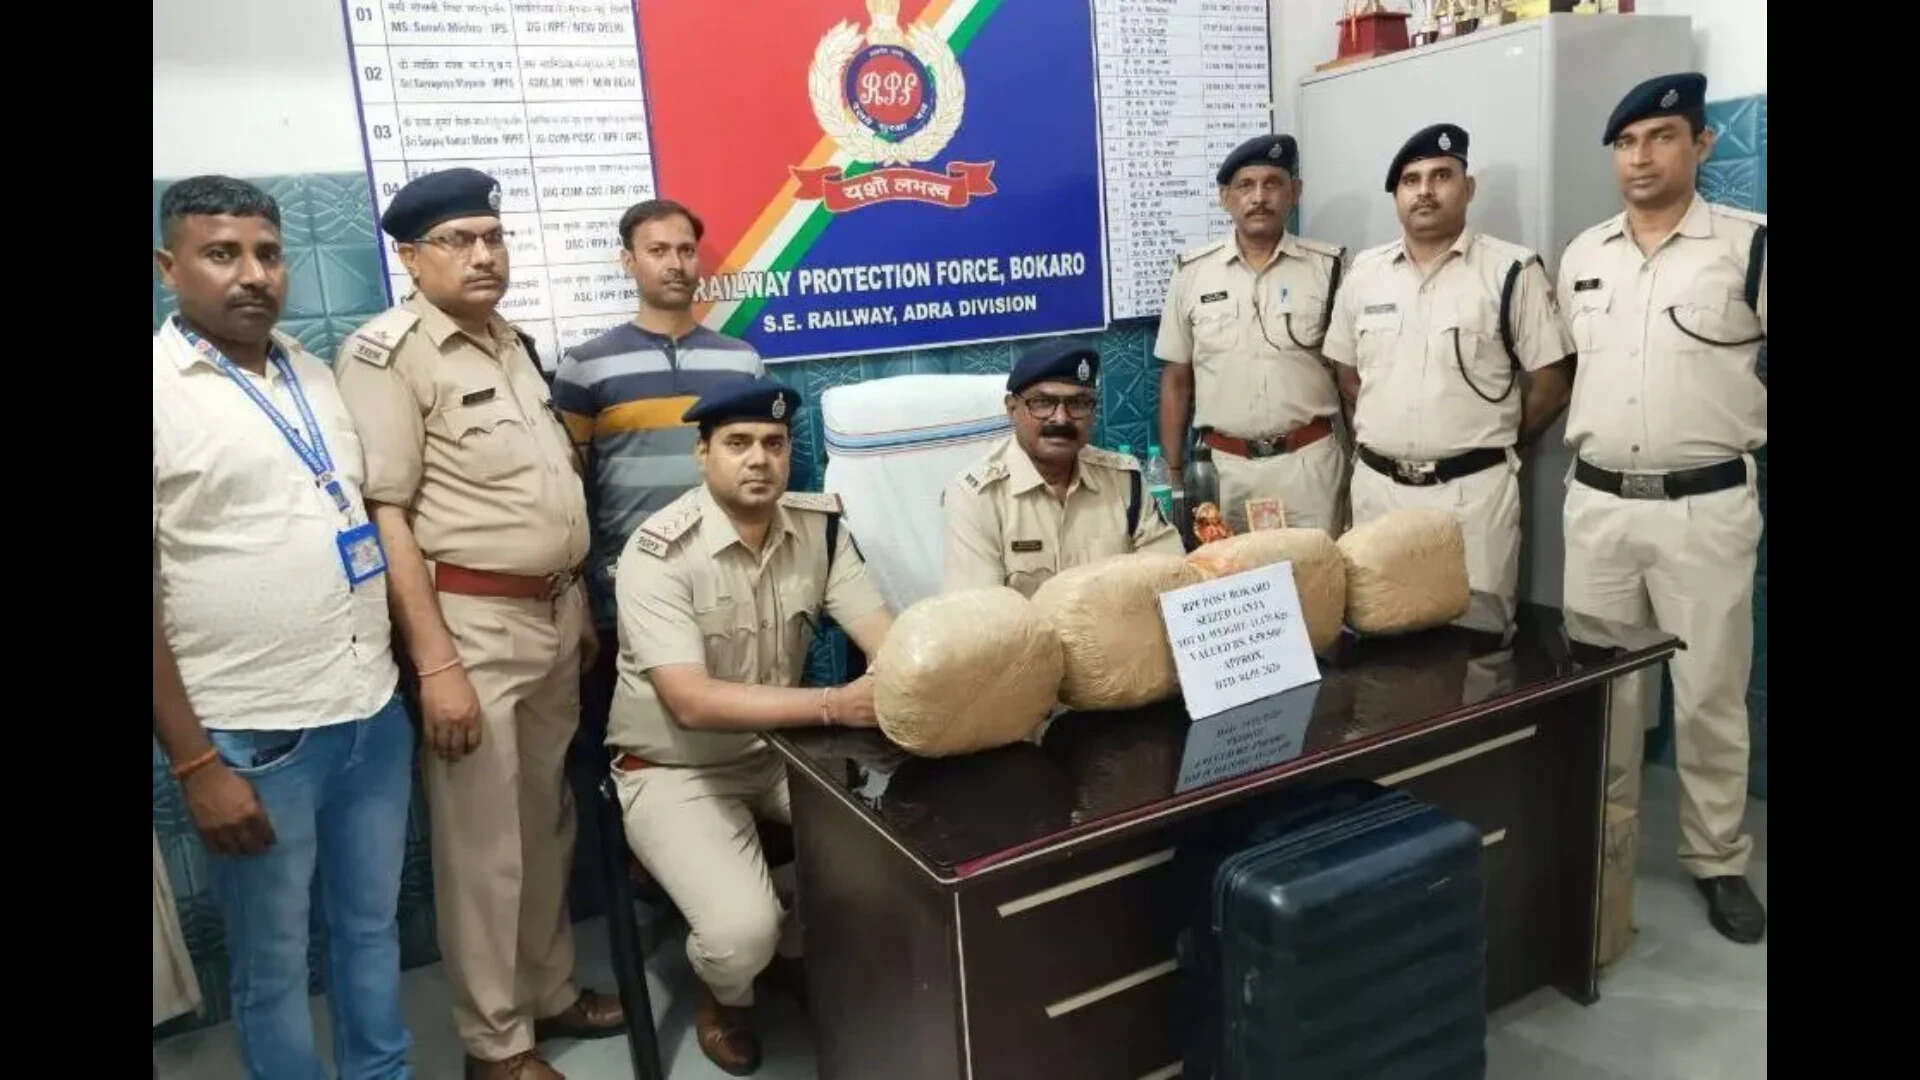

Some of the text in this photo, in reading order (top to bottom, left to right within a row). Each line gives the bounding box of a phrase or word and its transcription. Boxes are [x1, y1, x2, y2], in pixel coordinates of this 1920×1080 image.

[355, 6, 373, 22] 01
[364, 66, 384, 82] 02
[373, 124, 393, 141] 03
[842, 176, 889, 200] यशो
[692, 252, 1085, 301] RAILWAY PROTECTION FORCE, BOKARO
[763, 294, 1037, 333] S.E. RAILWAY, ADRA DIVISION
